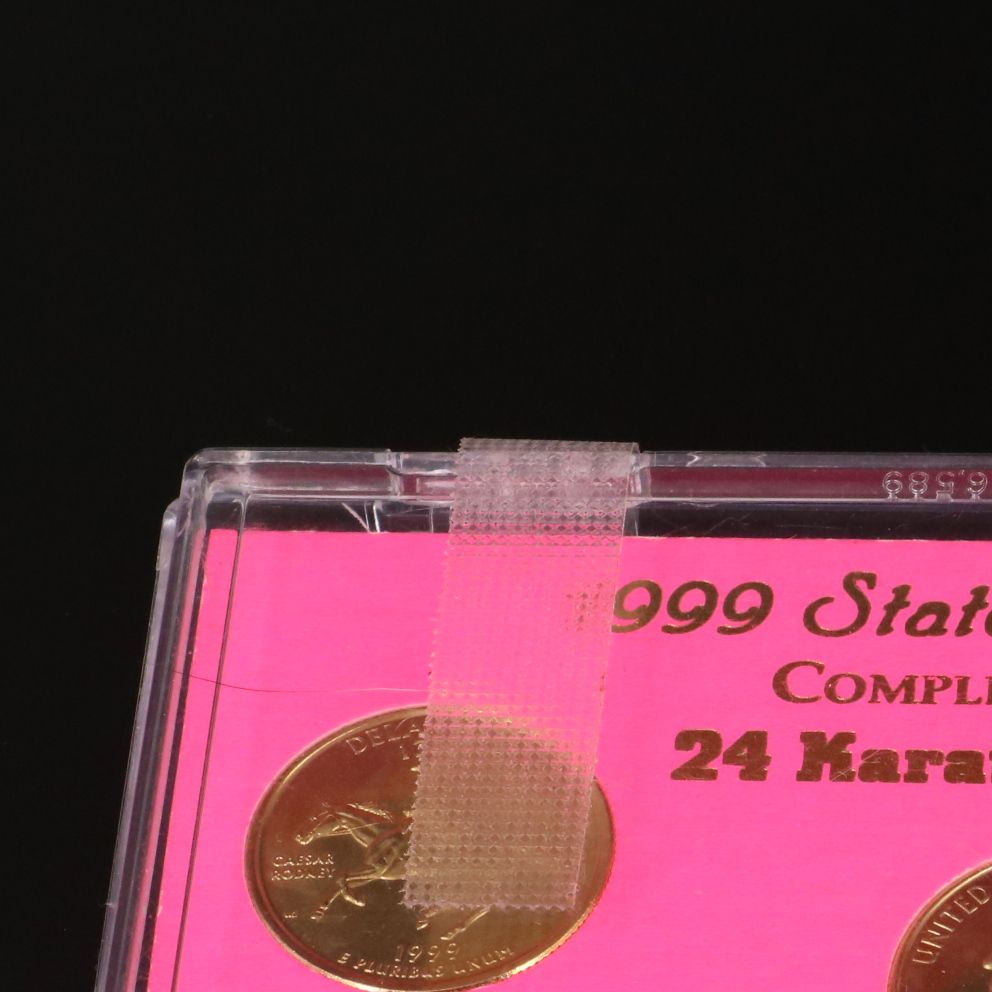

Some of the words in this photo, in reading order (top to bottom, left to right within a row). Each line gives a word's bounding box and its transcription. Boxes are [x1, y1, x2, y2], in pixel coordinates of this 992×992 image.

[580, 578, 774, 635] 999
[671, 729, 771, 780] 24
[912, 884, 991, 966] UNITED
